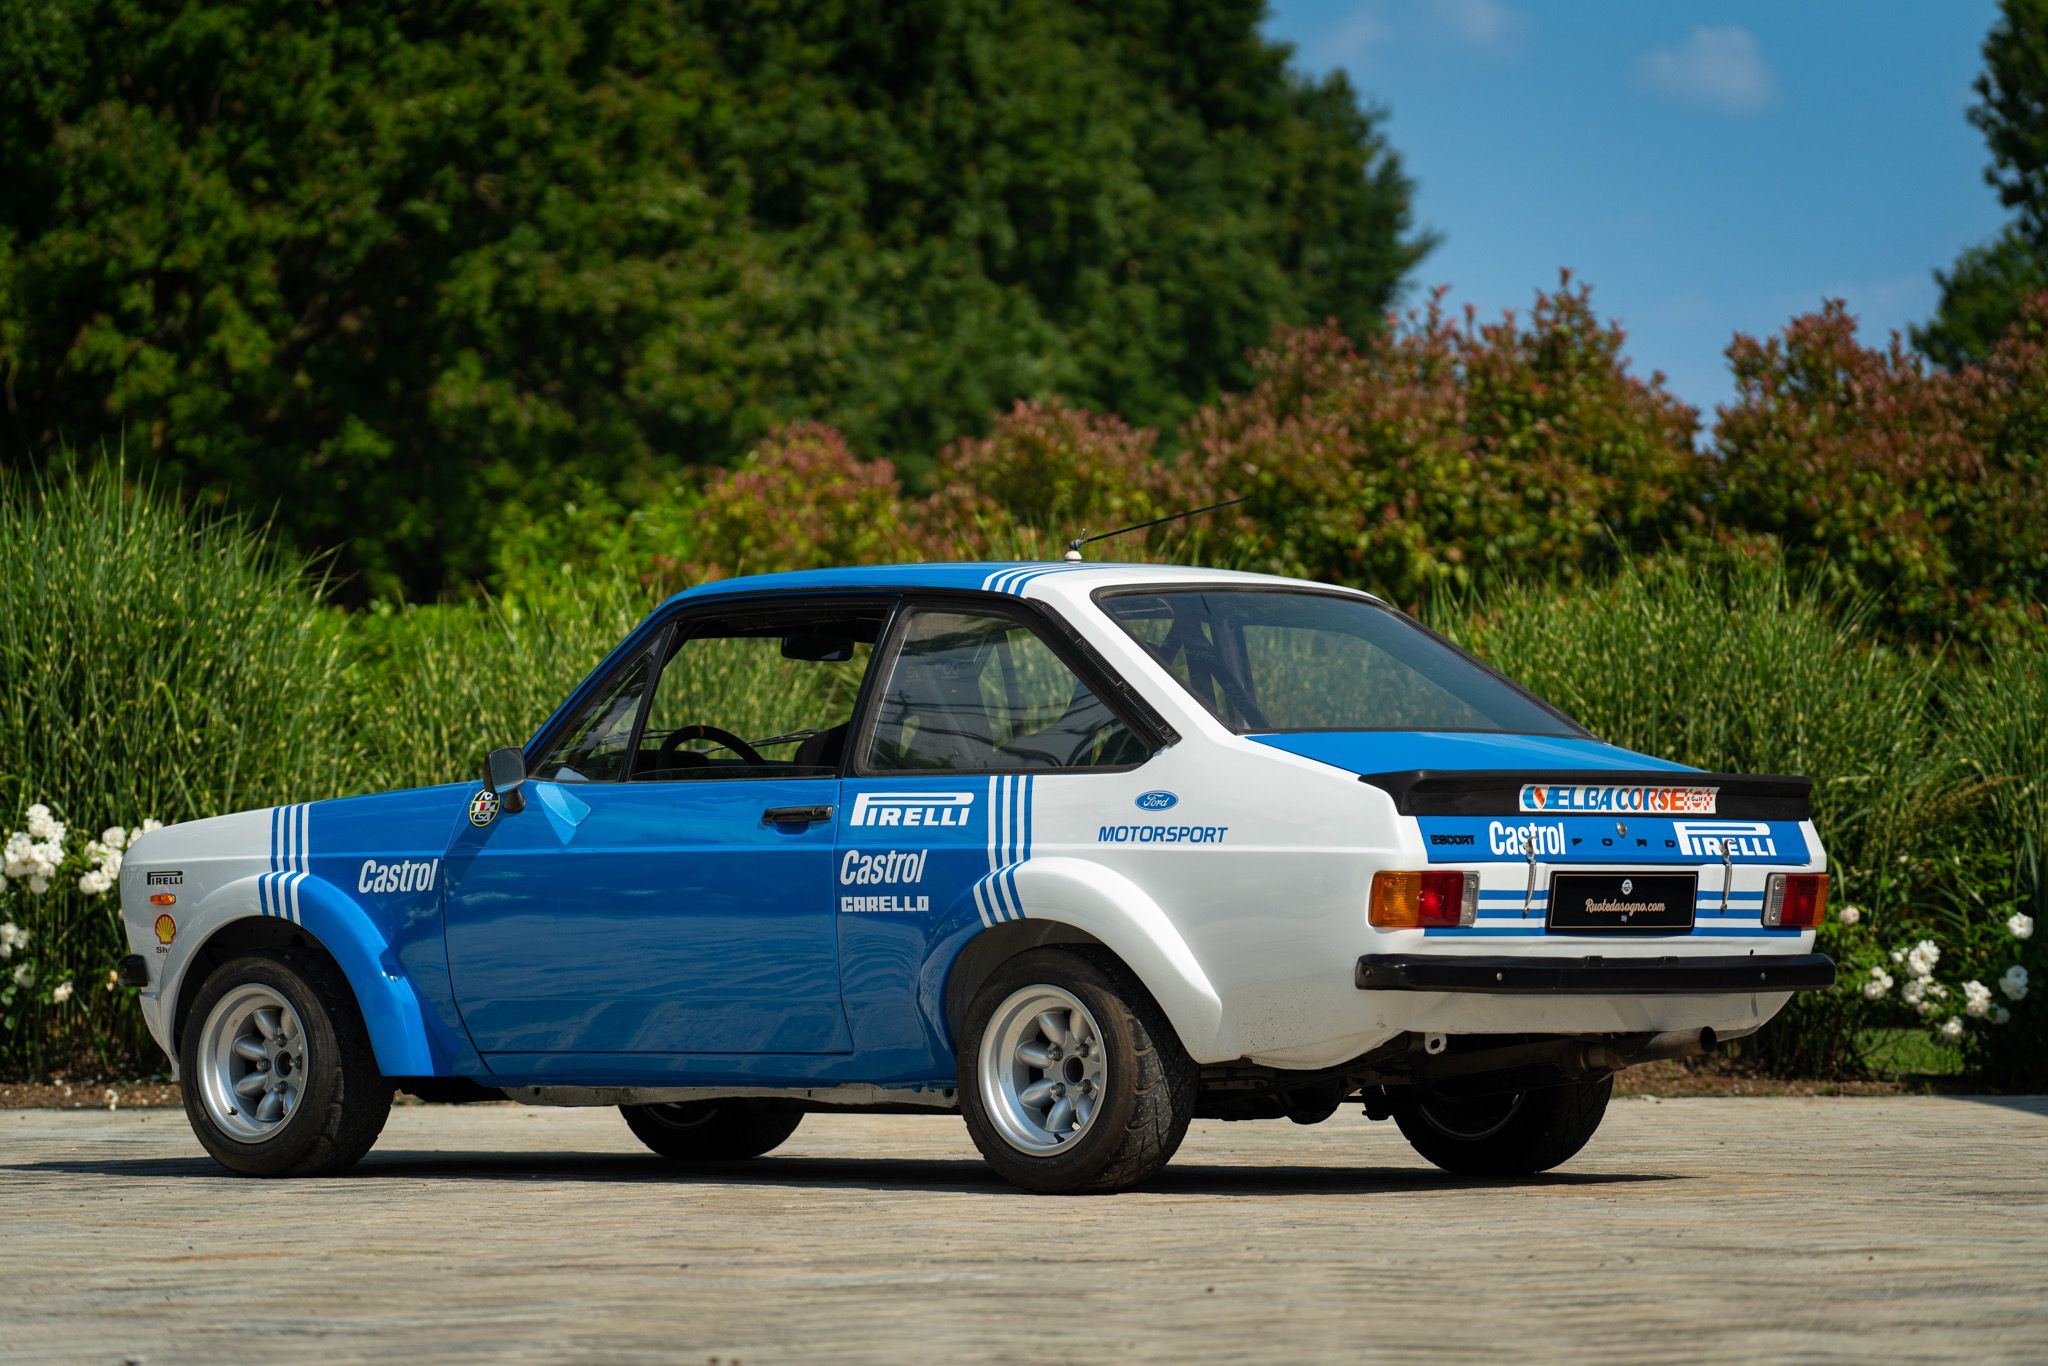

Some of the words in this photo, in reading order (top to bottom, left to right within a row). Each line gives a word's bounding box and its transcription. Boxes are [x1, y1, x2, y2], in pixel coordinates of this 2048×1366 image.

[850, 792, 974, 826] PIRELLI
[1143, 794, 1170, 807] Ford
[1546, 786, 1615, 810] ELBA
[1615, 787, 1686, 811] CORSE
[1098, 826, 1228, 843] MOTORSPORT
[1430, 835, 1474, 845] ESCORT
[1489, 821, 1566, 855] Castrol
[1673, 822, 1777, 856] PIRELLI
[147, 871, 183, 885] PIRELLI
[358, 858, 439, 893] Castrol
[840, 849, 928, 885] Castrol
[841, 896, 929, 912] CARELLO
[1585, 898, 1666, 917] Ruotedasogno.com
